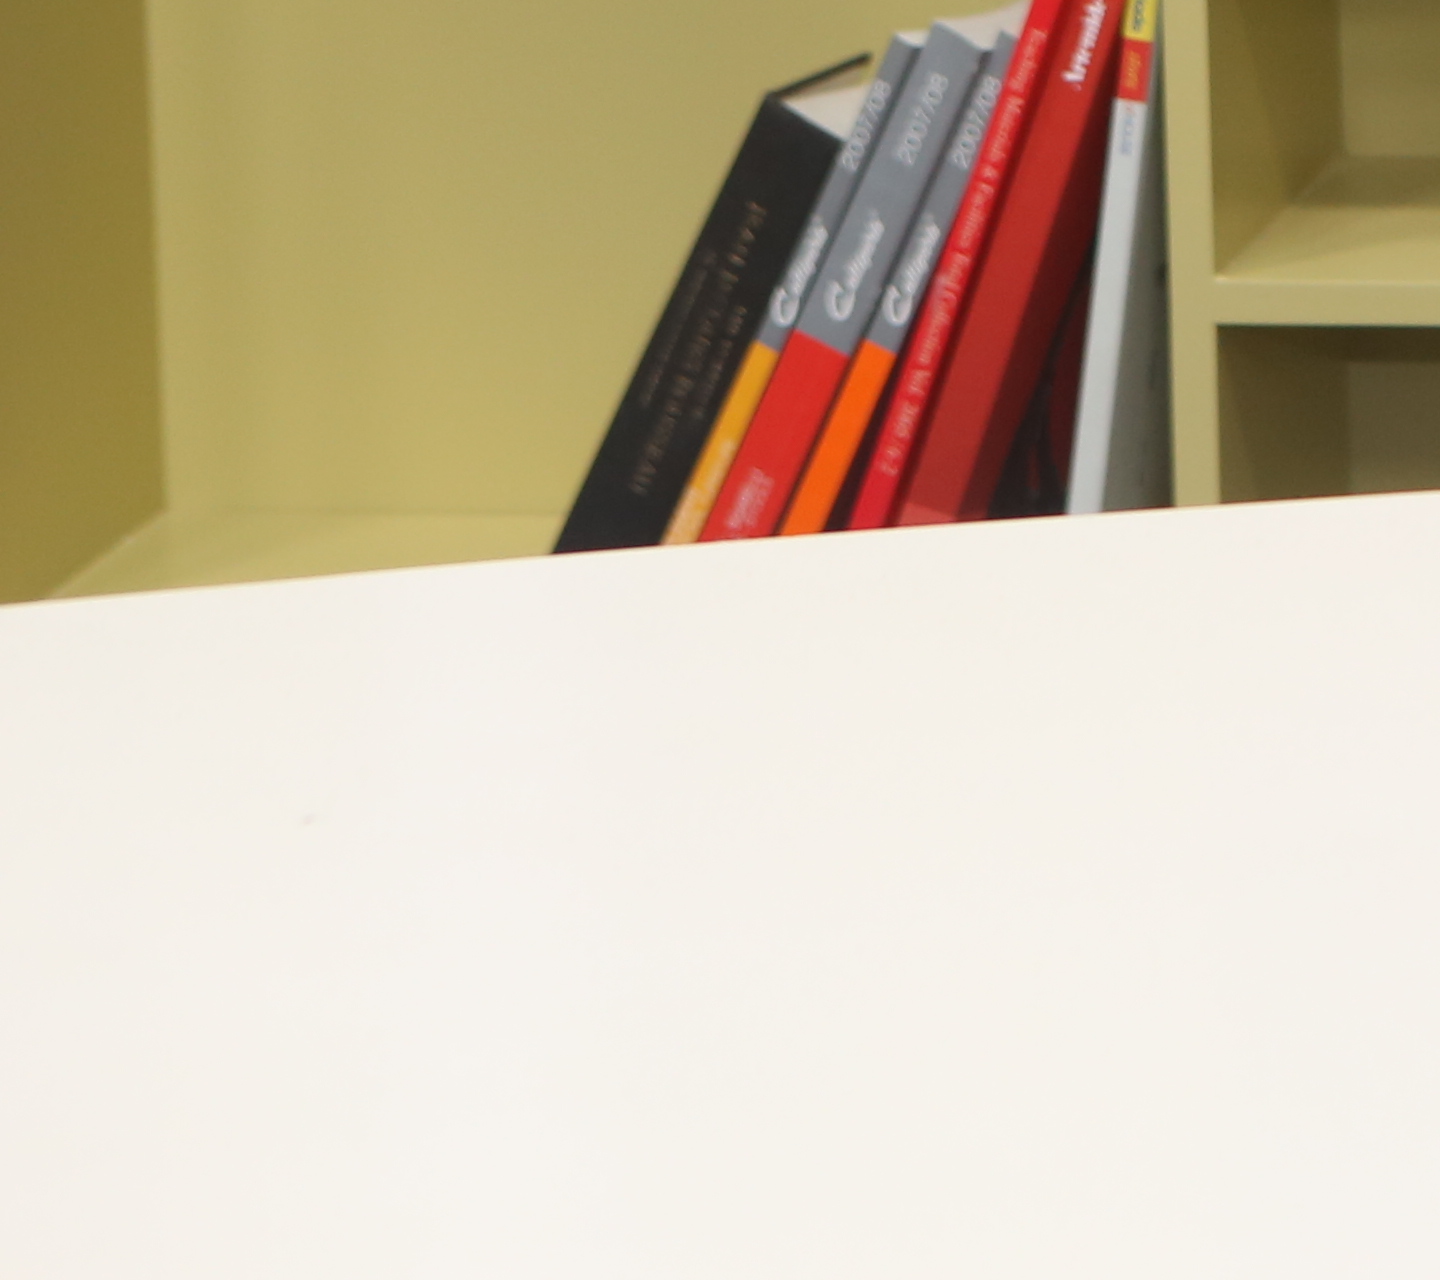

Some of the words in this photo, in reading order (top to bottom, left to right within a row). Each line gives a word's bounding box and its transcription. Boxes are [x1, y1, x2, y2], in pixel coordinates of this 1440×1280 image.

[836, 76, 894, 173] 2007/08
[891, 69, 955, 168] 2007/08
[946, 73, 1007, 171] 2007/08
